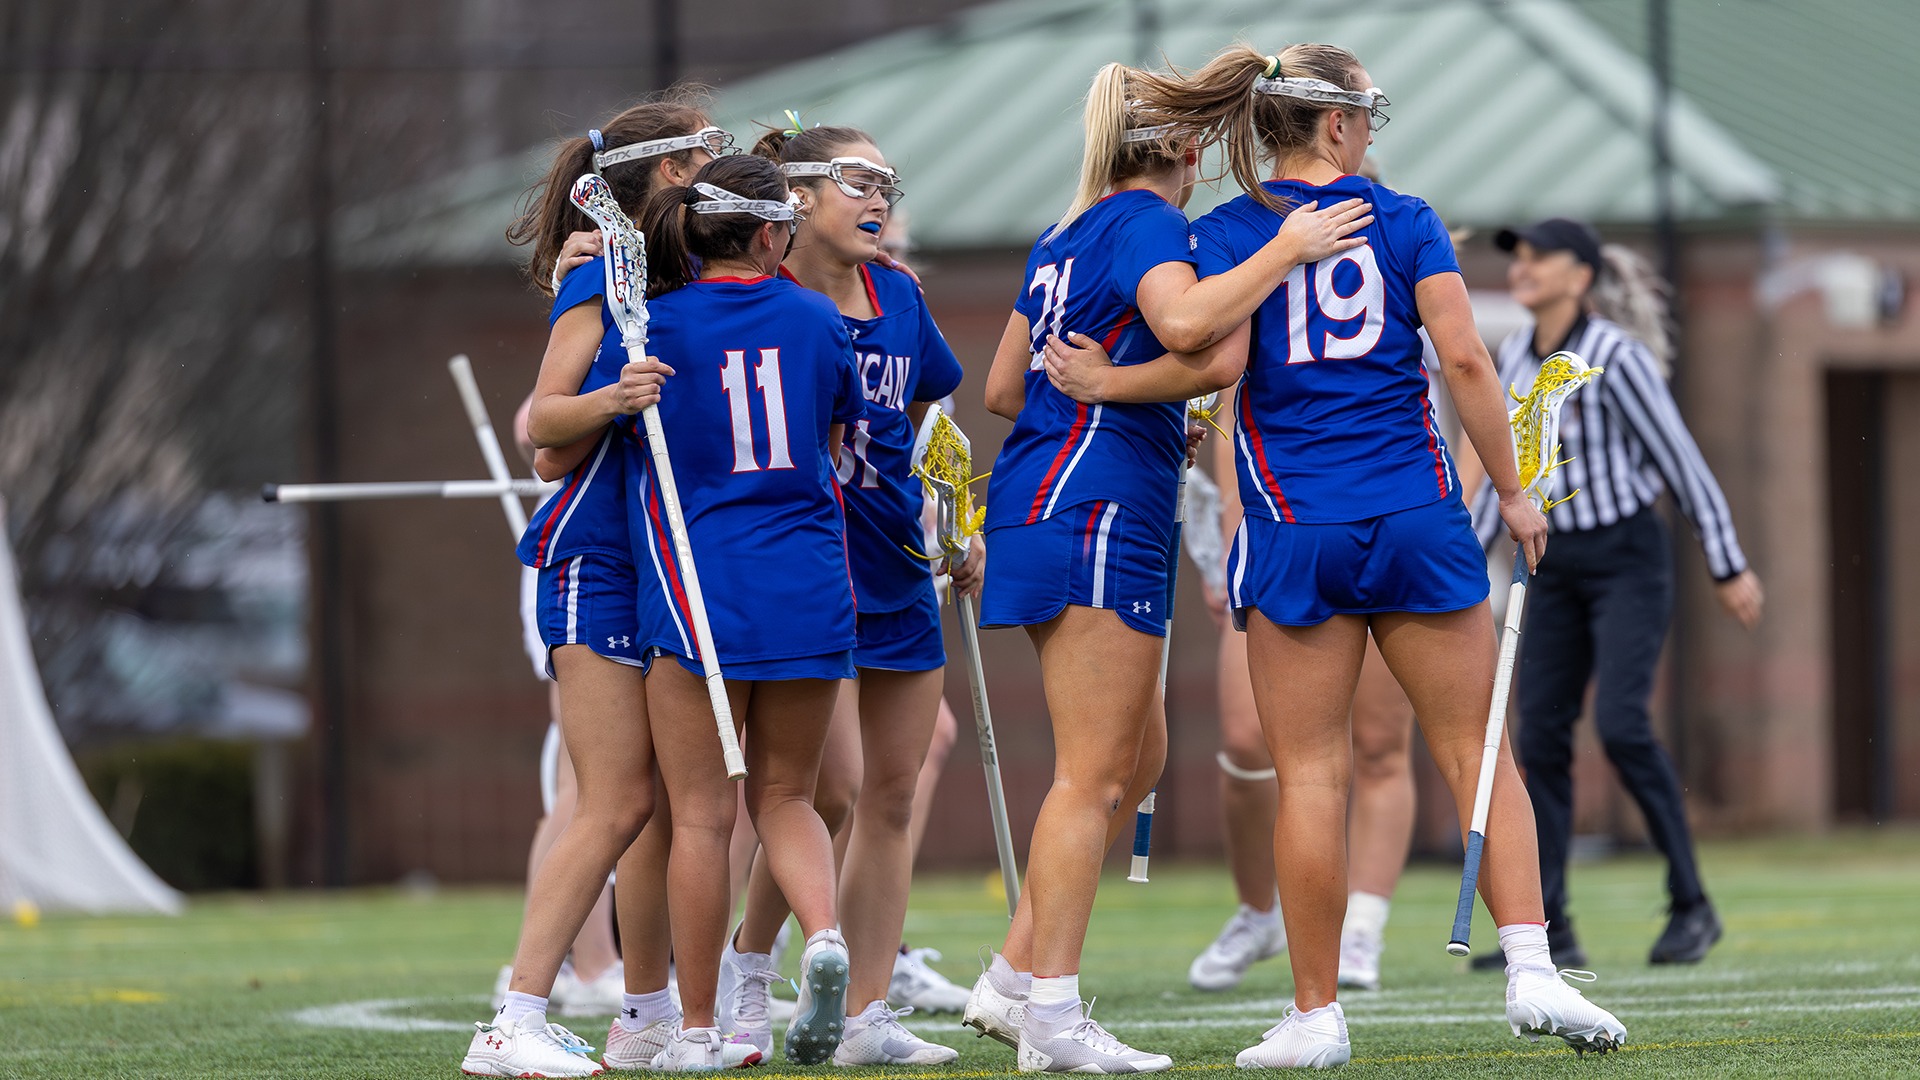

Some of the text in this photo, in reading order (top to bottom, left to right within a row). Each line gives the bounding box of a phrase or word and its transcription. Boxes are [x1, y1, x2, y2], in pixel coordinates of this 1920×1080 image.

[1264, 83, 1294, 95] STX
[1305, 88, 1339, 101] STX
[605, 149, 632, 164] STX
[641, 140, 677, 156] STX
[732, 201, 766, 212] STX
[1281, 235, 1385, 365] 19
[719, 346, 797, 474] 11
